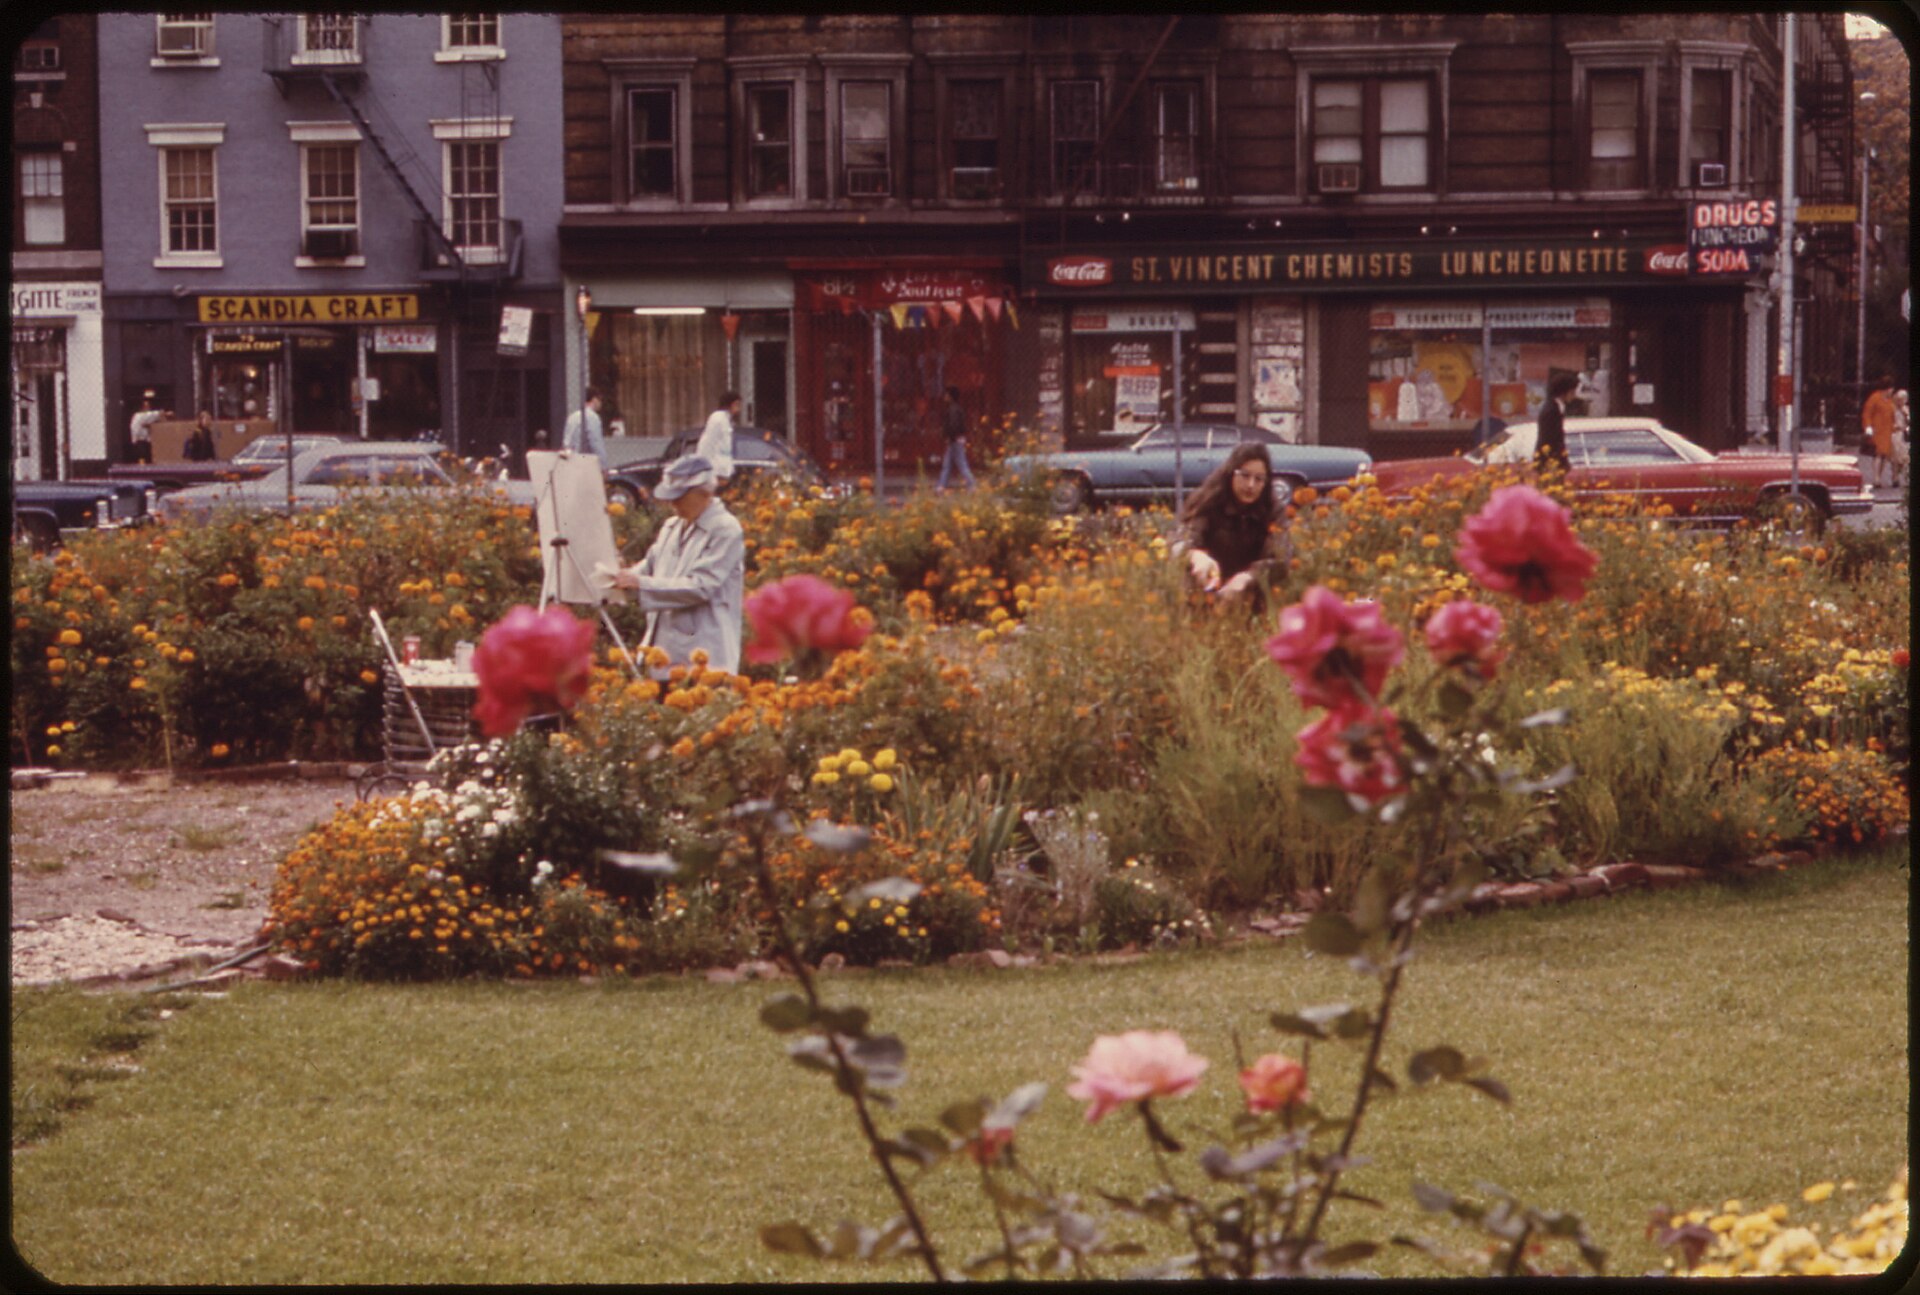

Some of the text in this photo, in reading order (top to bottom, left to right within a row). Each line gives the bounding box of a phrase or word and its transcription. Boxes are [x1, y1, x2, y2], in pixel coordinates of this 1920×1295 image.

[1695, 201, 1777, 228] DRUGS
[1132, 248, 1628, 281] ST. VINCENT CHEMISTS LUNCHEONETTE
[1697, 250, 1750, 273] SODA
[208, 297, 409, 319] SCANDIA CRAFT
